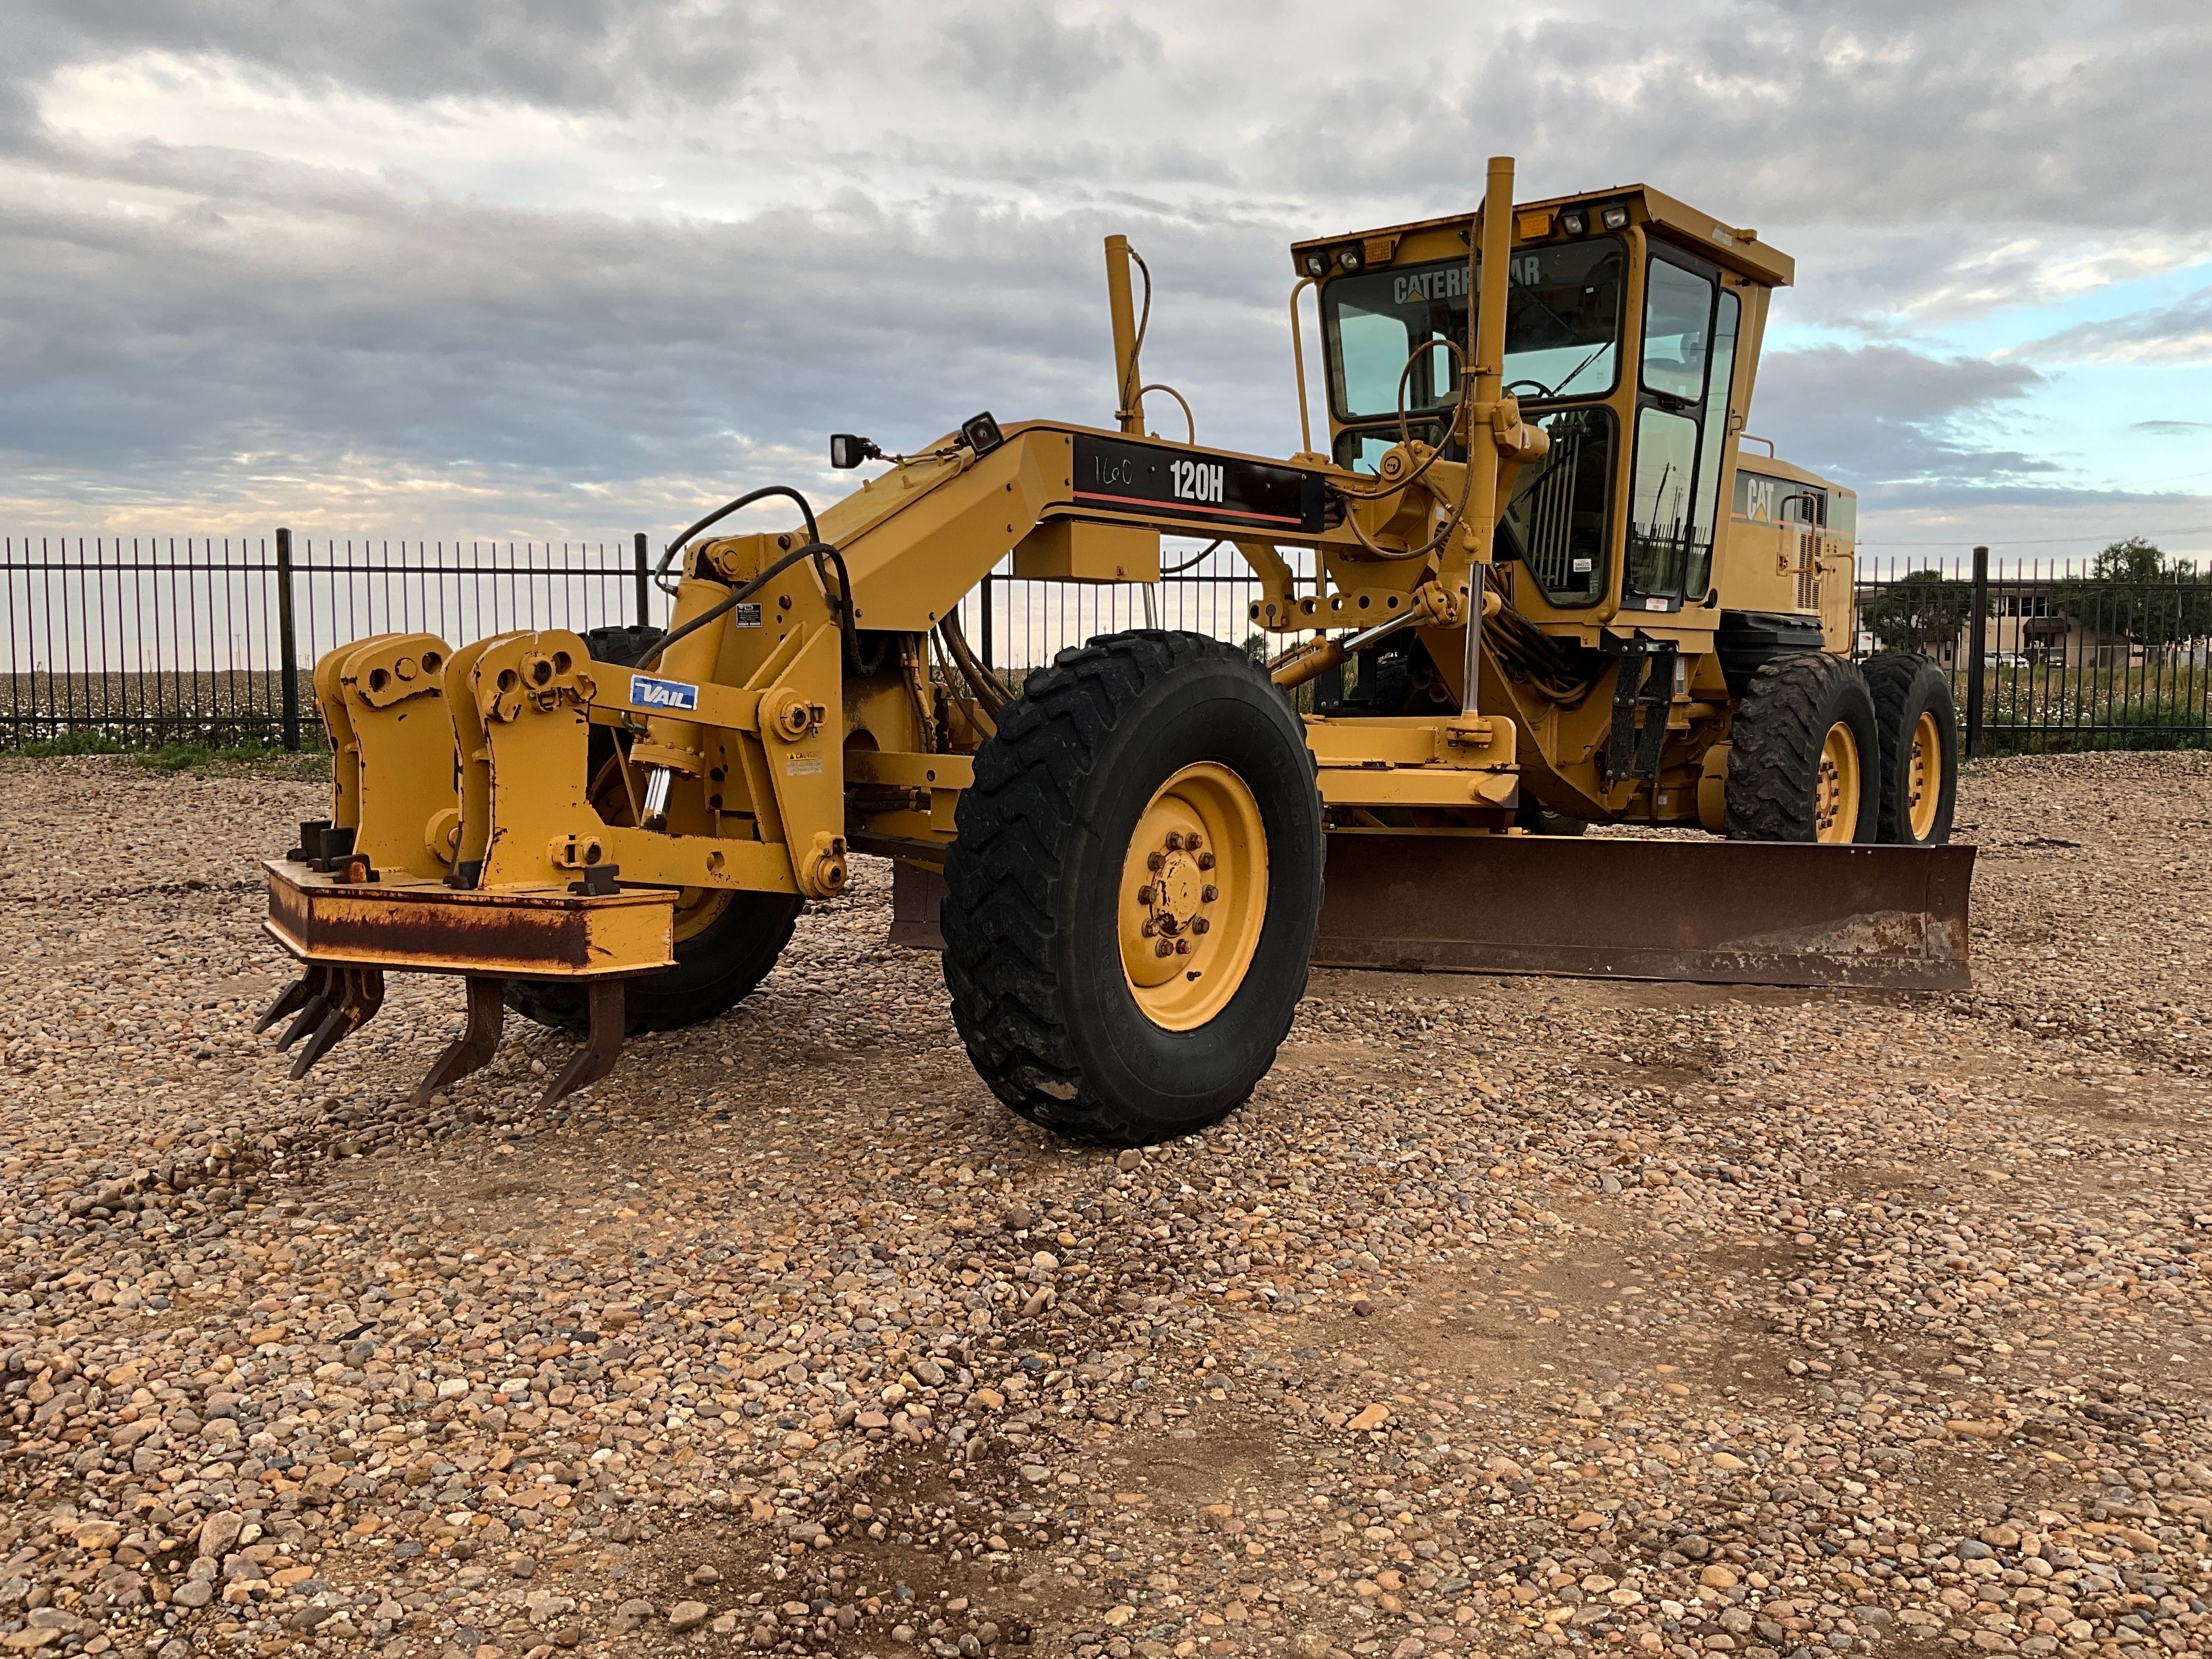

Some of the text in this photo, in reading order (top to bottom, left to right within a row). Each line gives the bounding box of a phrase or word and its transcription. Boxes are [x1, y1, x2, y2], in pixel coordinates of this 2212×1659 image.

[1394, 256, 1539, 304] CATERPIAR
[1170, 460, 1224, 503] 120H
[1747, 478, 1774, 523] CAT
[635, 682, 692, 709] VAIL
